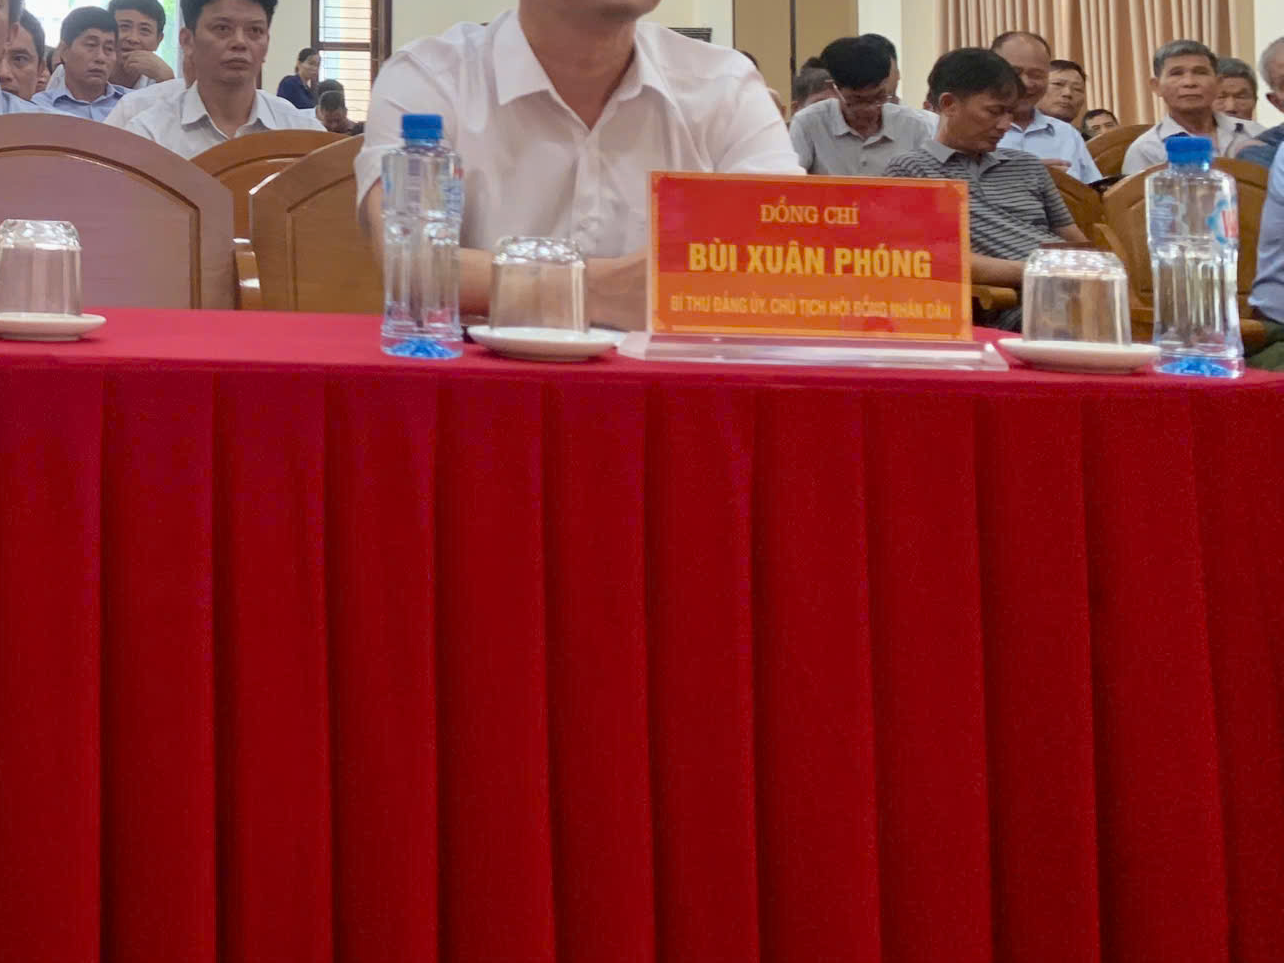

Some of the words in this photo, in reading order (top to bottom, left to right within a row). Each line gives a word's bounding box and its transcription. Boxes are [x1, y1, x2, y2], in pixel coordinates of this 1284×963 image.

[824, 201, 860, 225] CHÍ
[688, 237, 738, 272] BÙI
[746, 240, 826, 275] XUÂN
